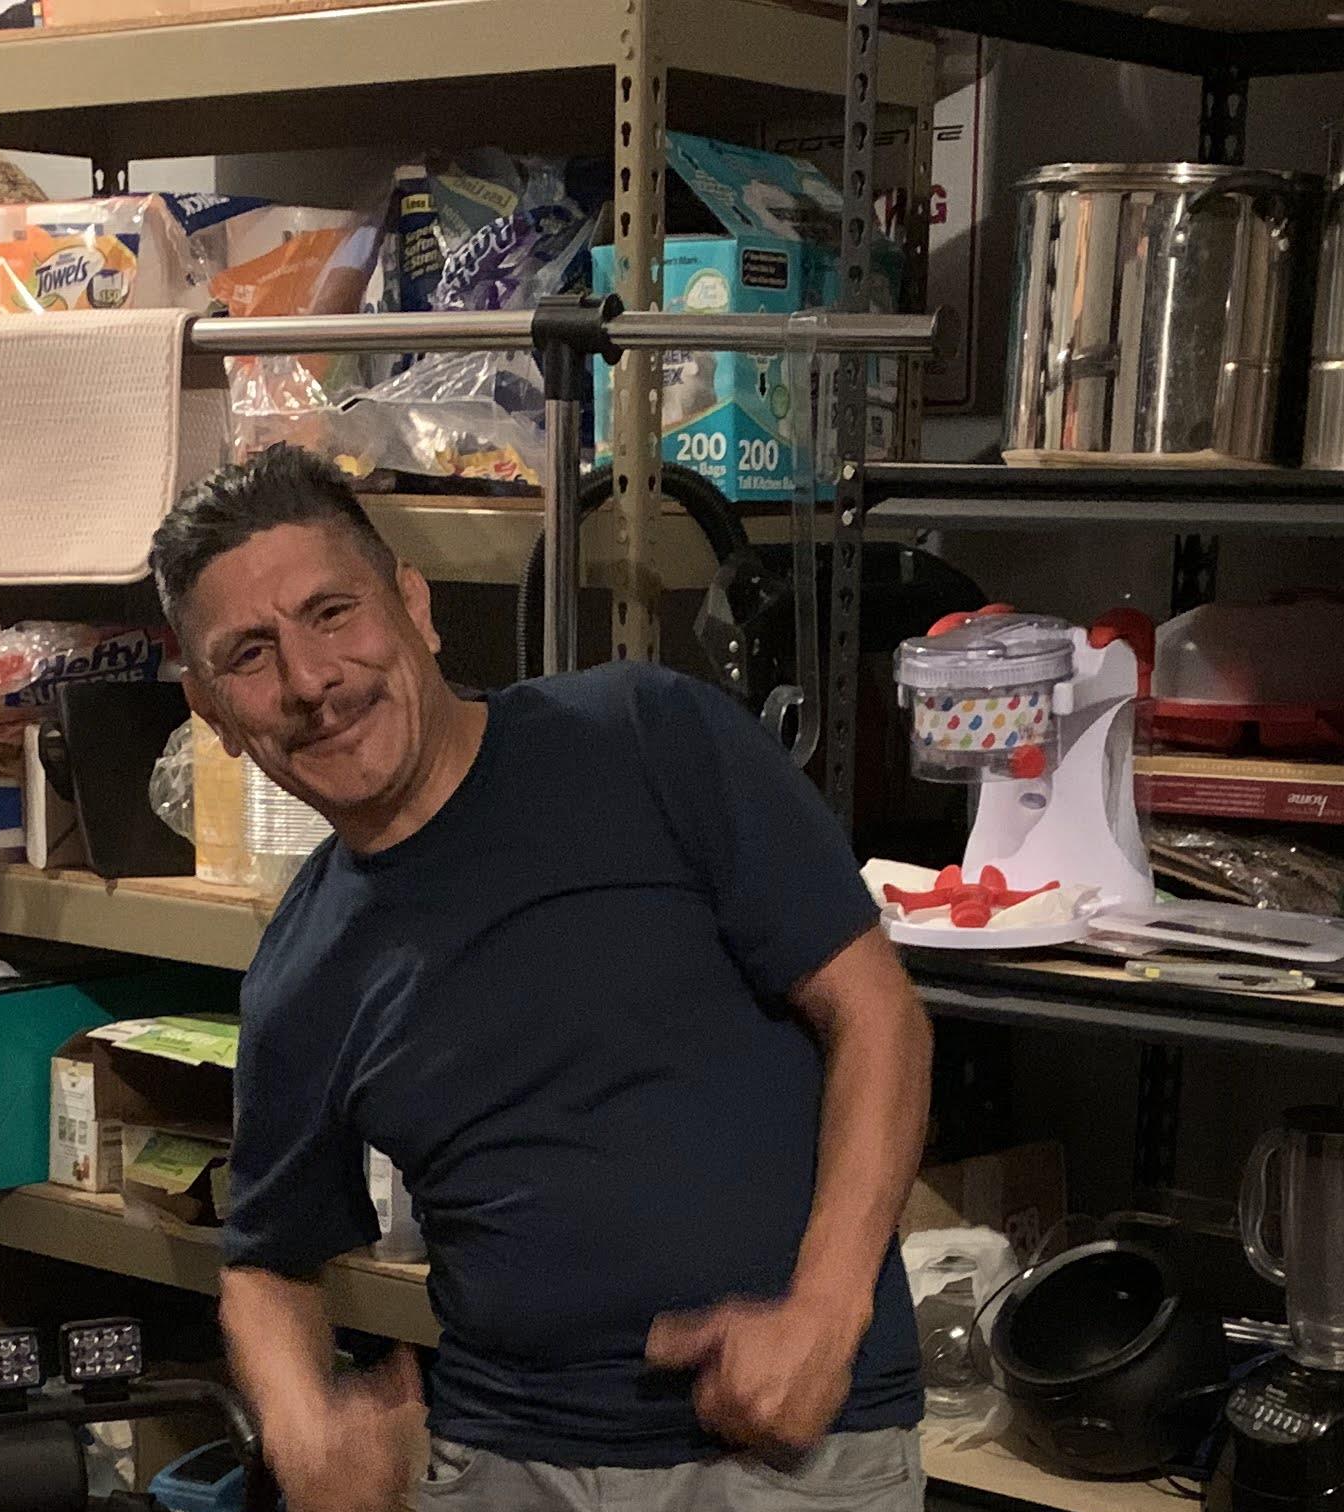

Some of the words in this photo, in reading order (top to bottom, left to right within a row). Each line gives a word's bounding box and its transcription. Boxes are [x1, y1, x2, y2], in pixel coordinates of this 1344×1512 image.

[36, 256, 89, 297] Towels
[676, 432, 727, 461] 200
[738, 439, 779, 471] 200
[1288, 793, 1328, 817] home
